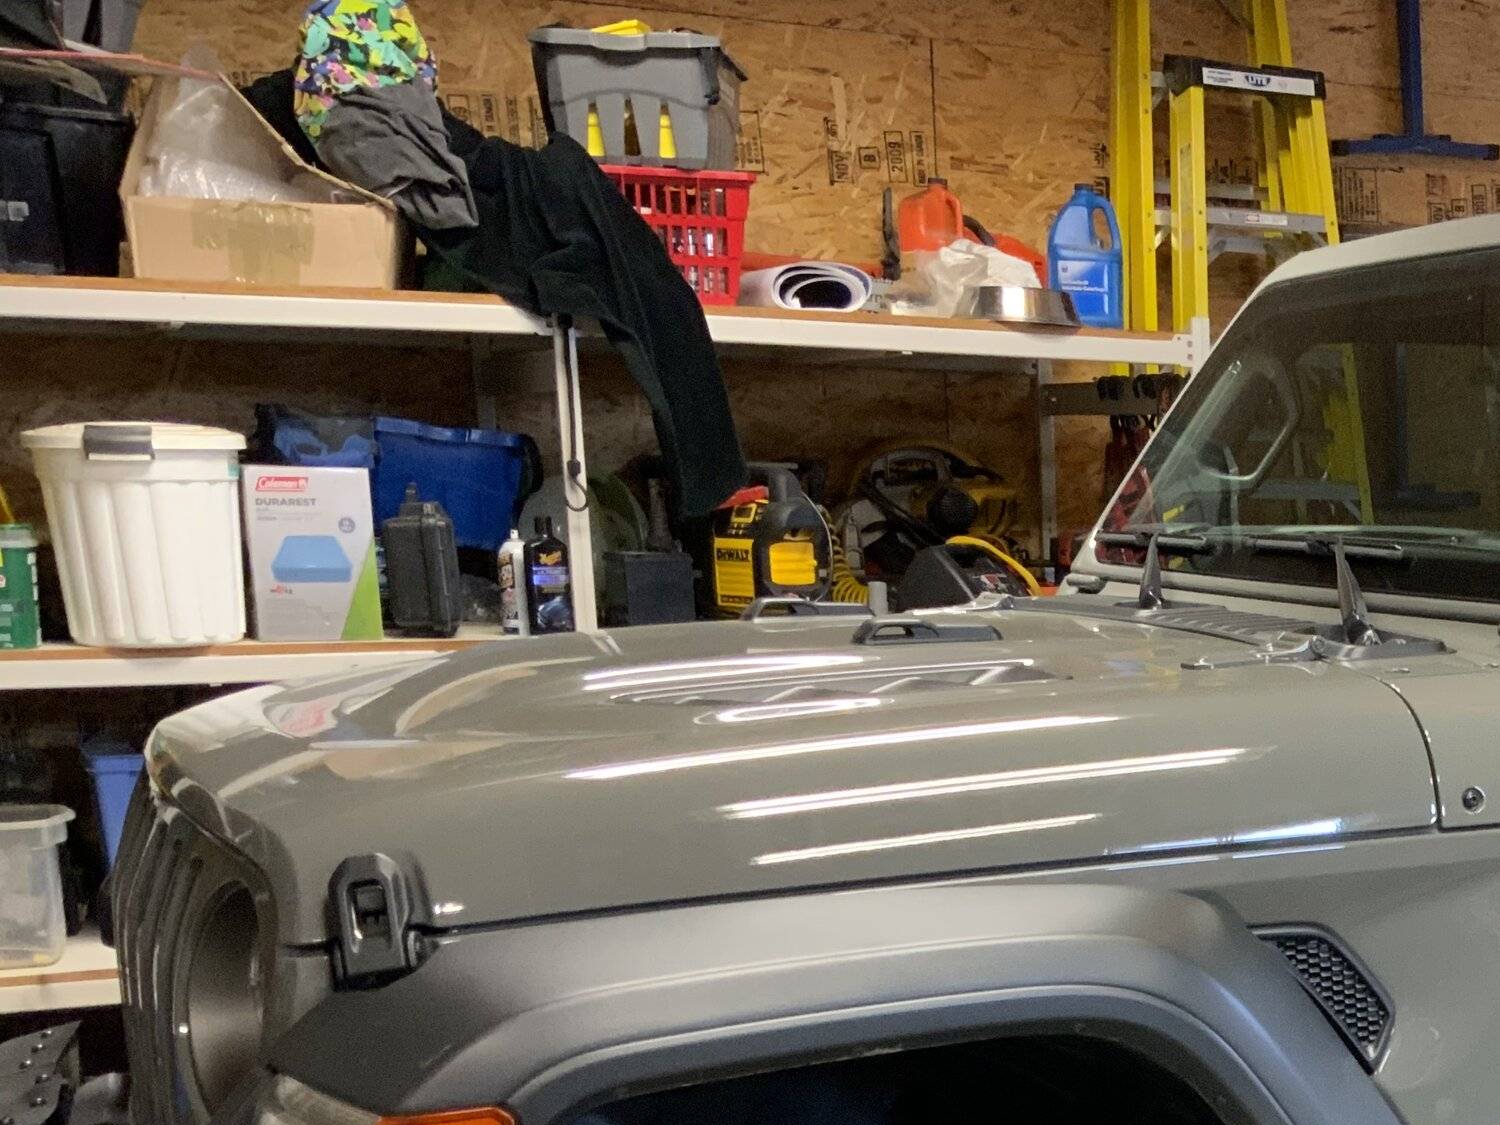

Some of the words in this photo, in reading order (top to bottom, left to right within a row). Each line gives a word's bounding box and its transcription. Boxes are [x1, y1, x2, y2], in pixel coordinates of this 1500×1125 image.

[888, 141, 903, 173] 2009
[259, 477, 299, 490] Coleman
[255, 497, 317, 507] DURAREST
